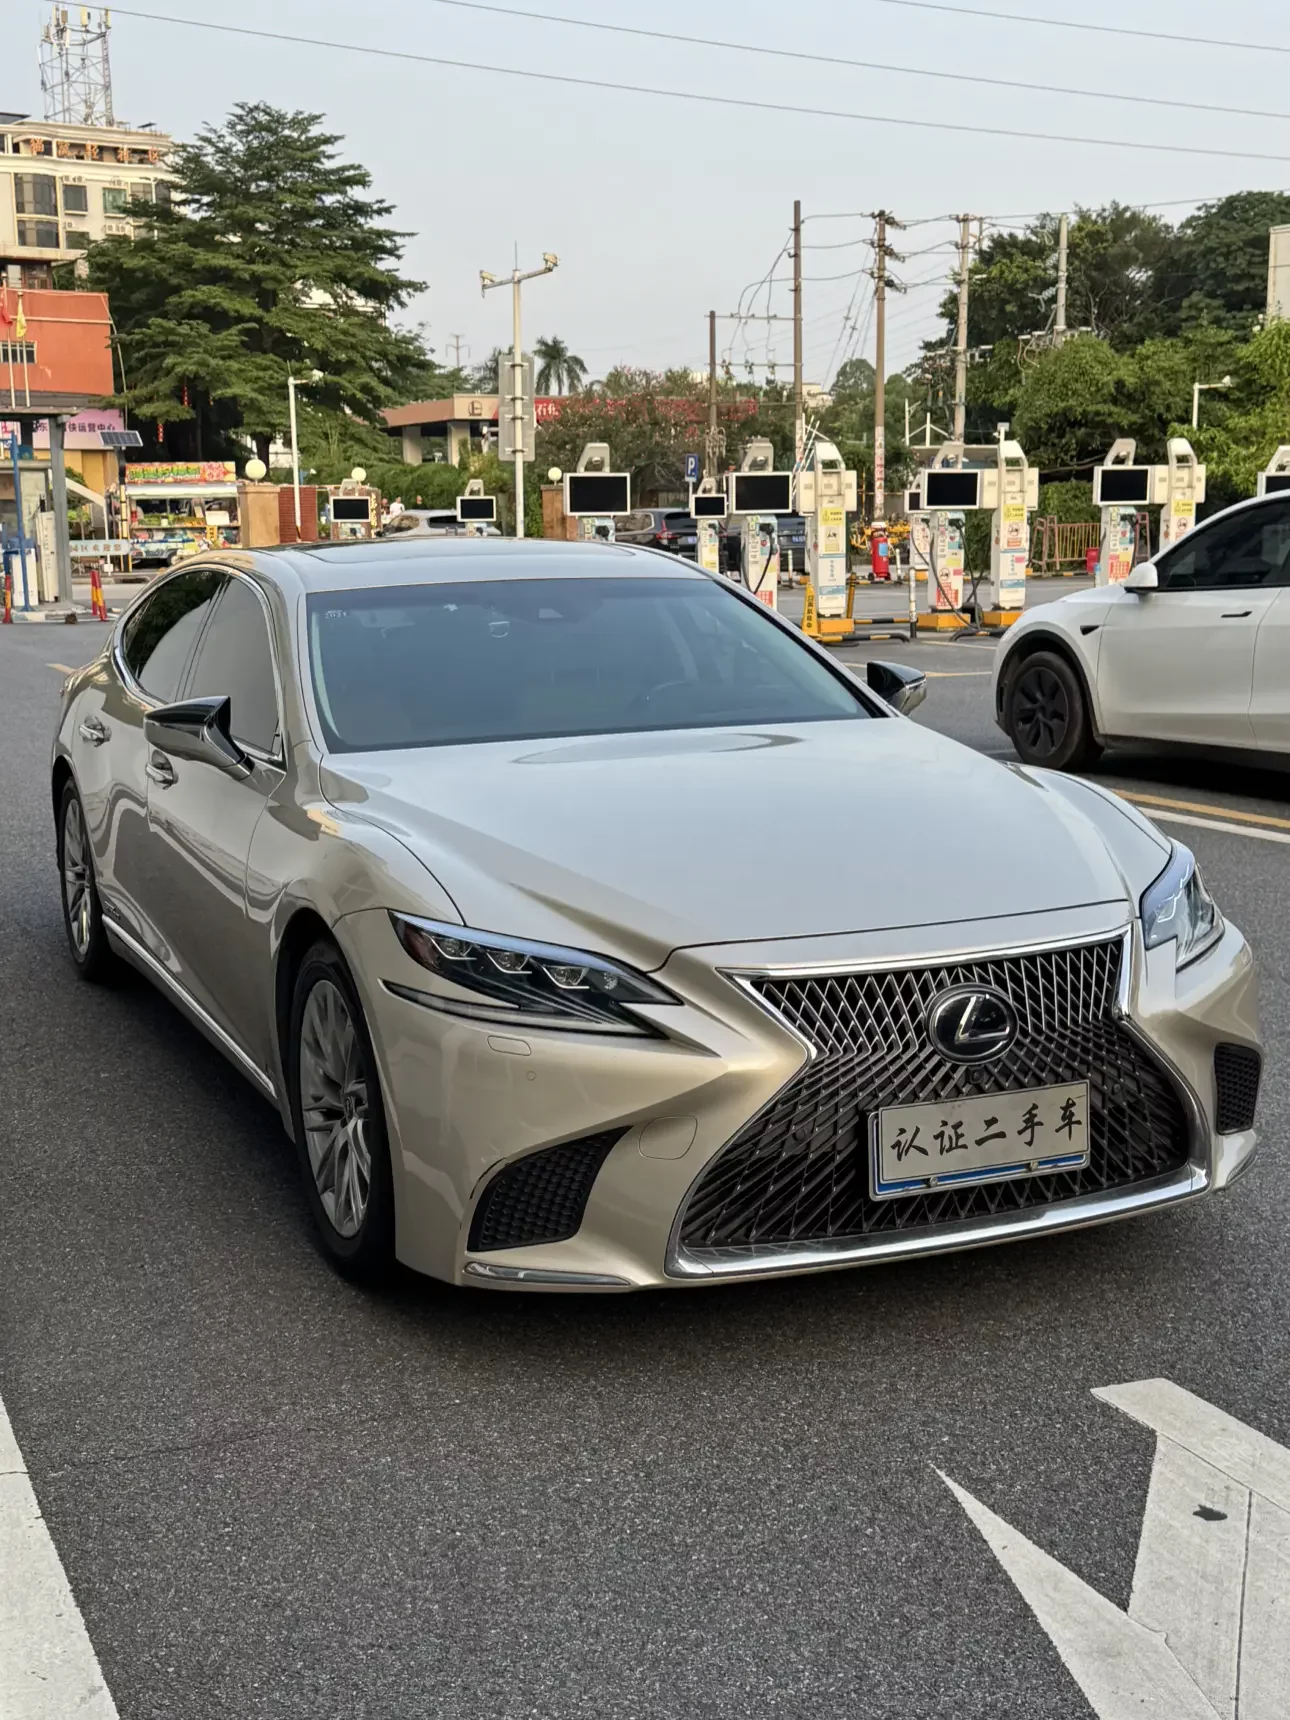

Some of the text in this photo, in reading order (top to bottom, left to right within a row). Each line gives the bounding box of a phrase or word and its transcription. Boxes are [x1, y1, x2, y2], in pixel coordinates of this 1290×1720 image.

[890, 1097, 1083, 1162] 认证二手车
